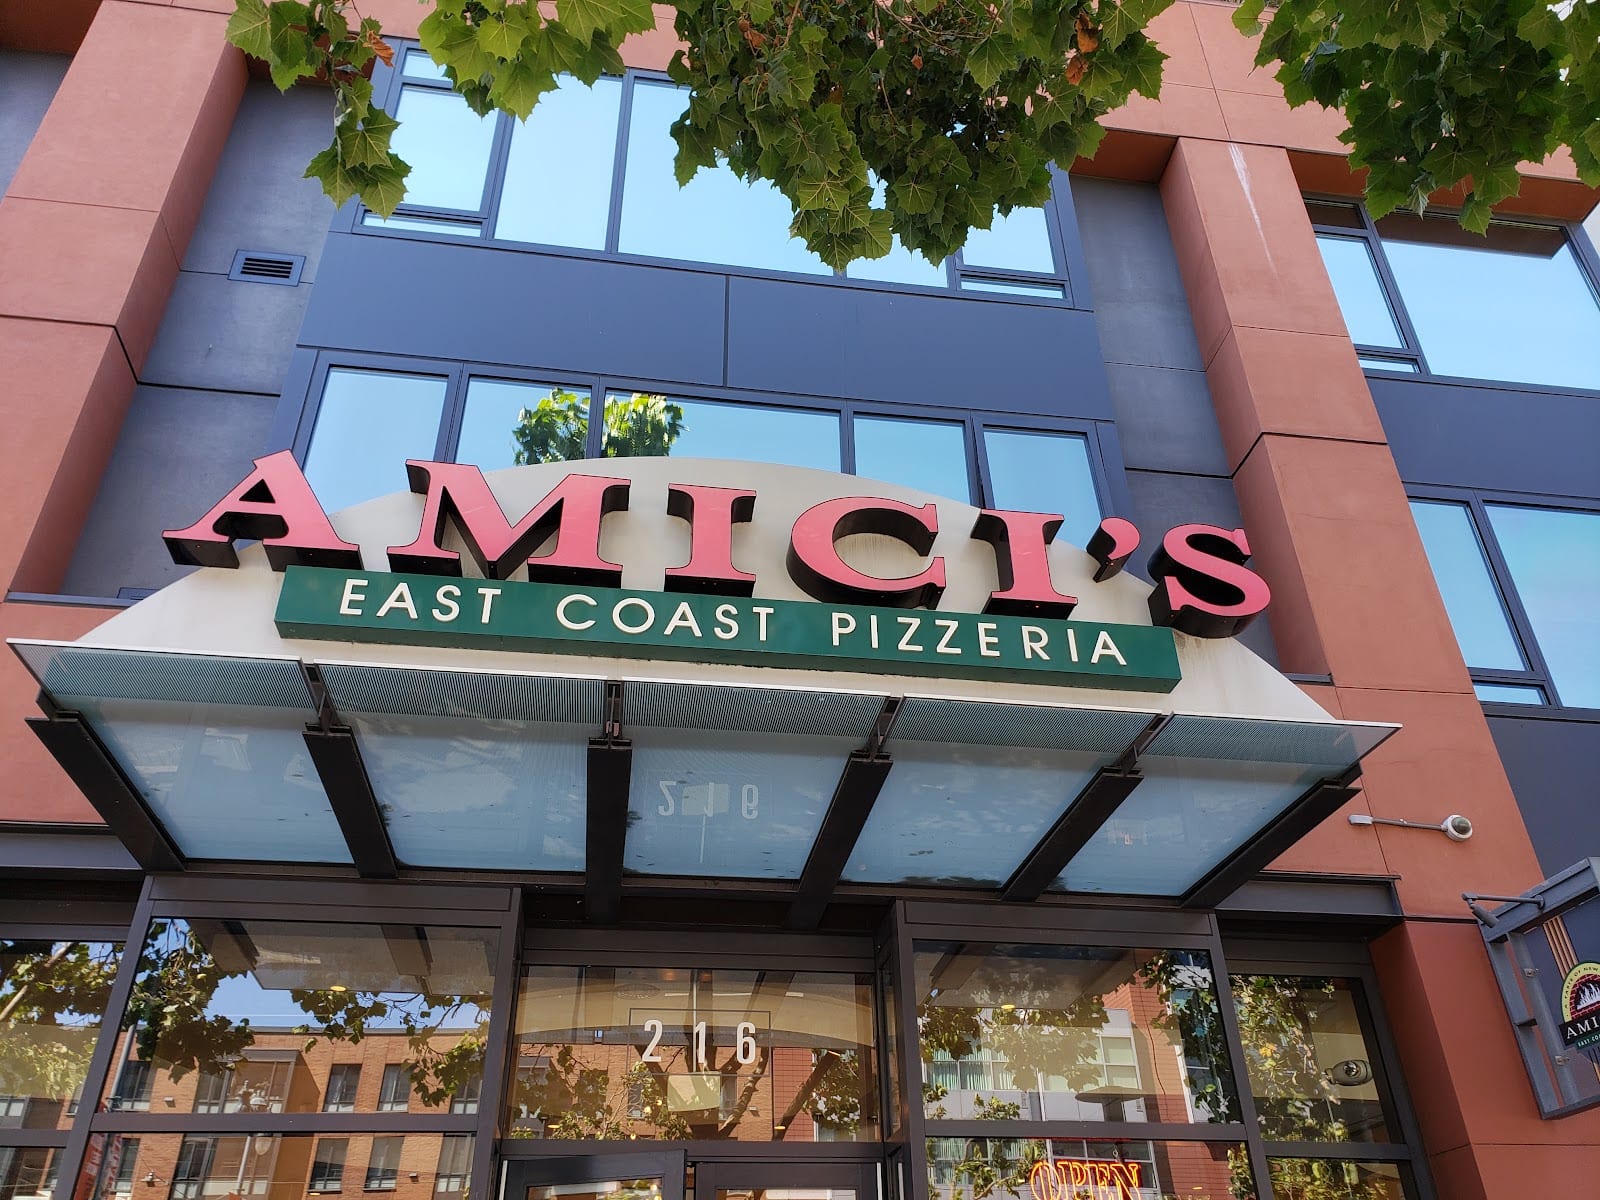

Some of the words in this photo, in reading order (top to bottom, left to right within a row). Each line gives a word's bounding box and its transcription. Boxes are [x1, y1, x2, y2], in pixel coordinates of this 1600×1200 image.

[163, 450, 1271, 638] AMICI'S
[340, 578, 503, 624] EAST
[556, 593, 776, 642] COAST
[831, 611, 1128, 667] PIZZERIA
[1577, 1038, 1591, 1047] EAST
